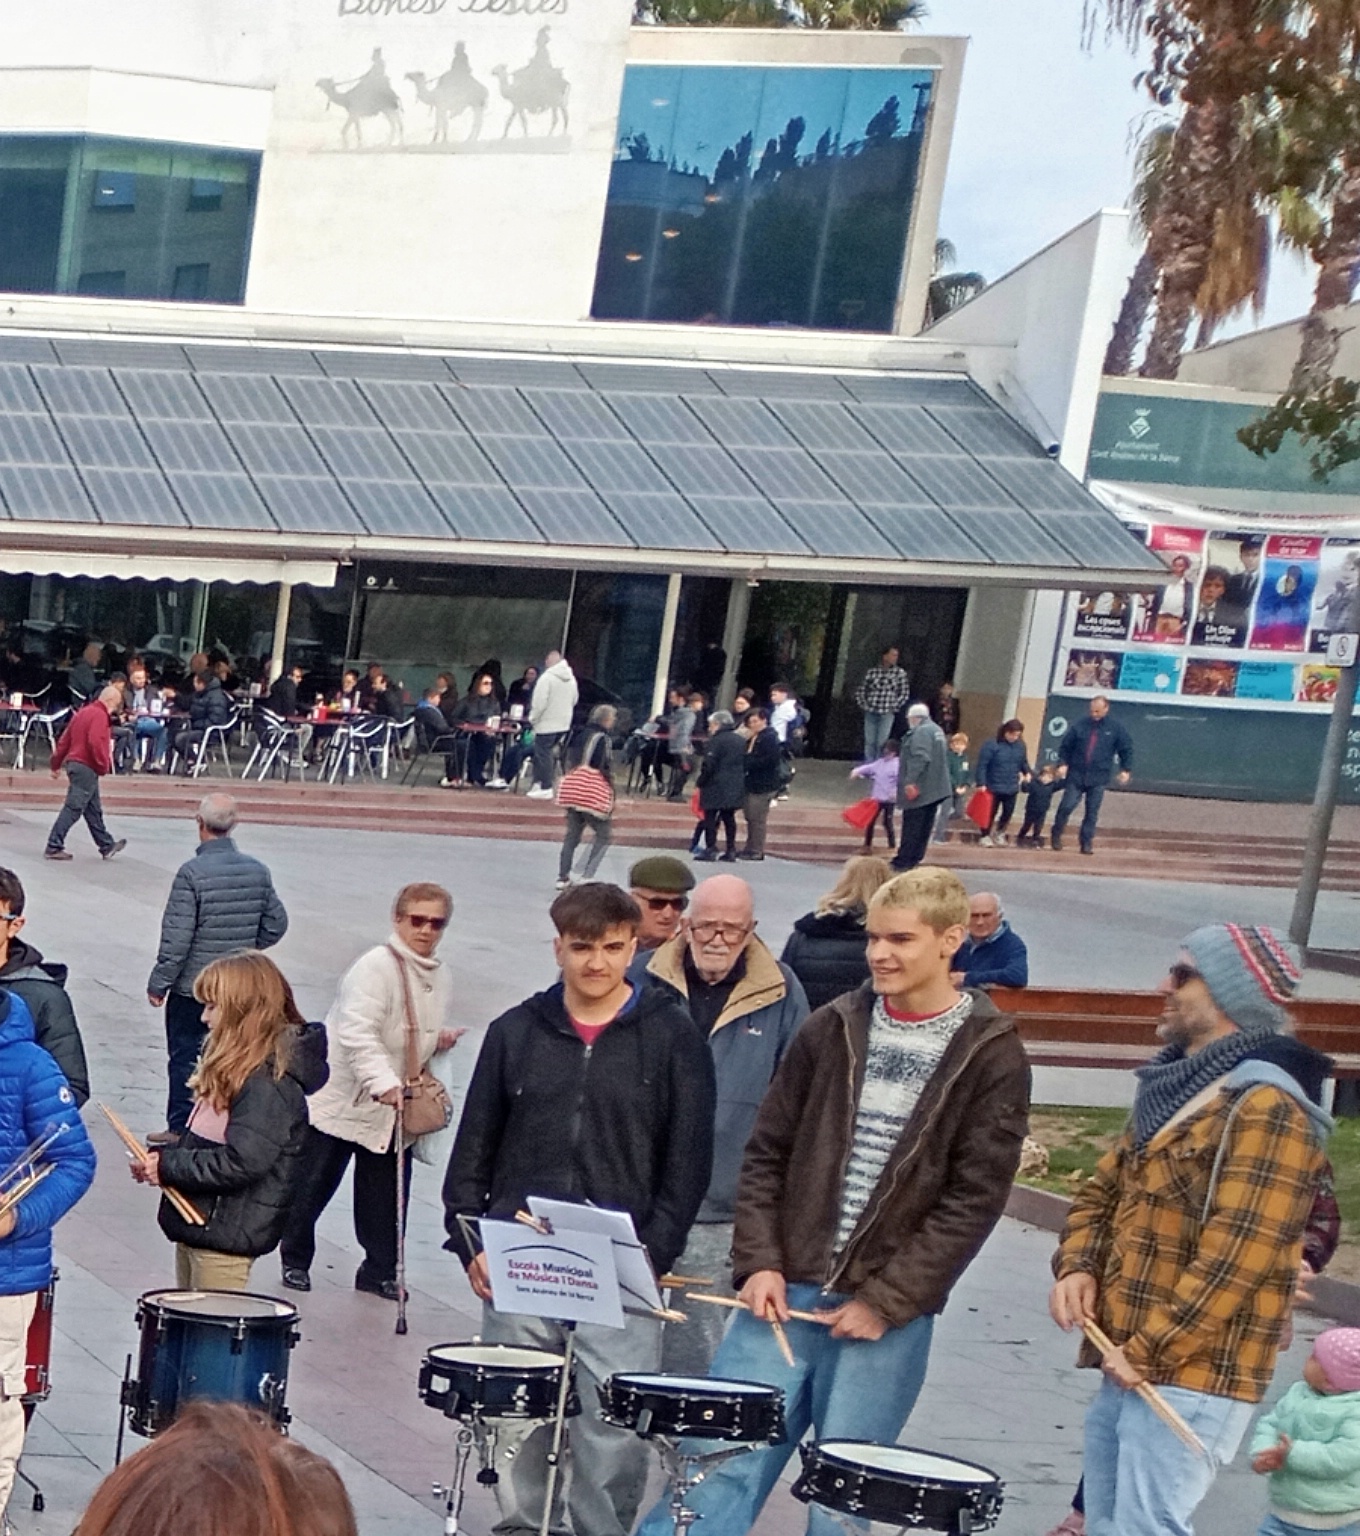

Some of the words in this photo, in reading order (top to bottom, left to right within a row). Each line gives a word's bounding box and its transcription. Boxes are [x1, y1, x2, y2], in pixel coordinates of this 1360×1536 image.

[507, 1259, 540, 1271] Escola
[542, 1262, 594, 1279] Municipal
[507, 1269, 520, 1280] de
[522, 1270, 560, 1285] Música
[567, 1276, 599, 1291] Dansa
